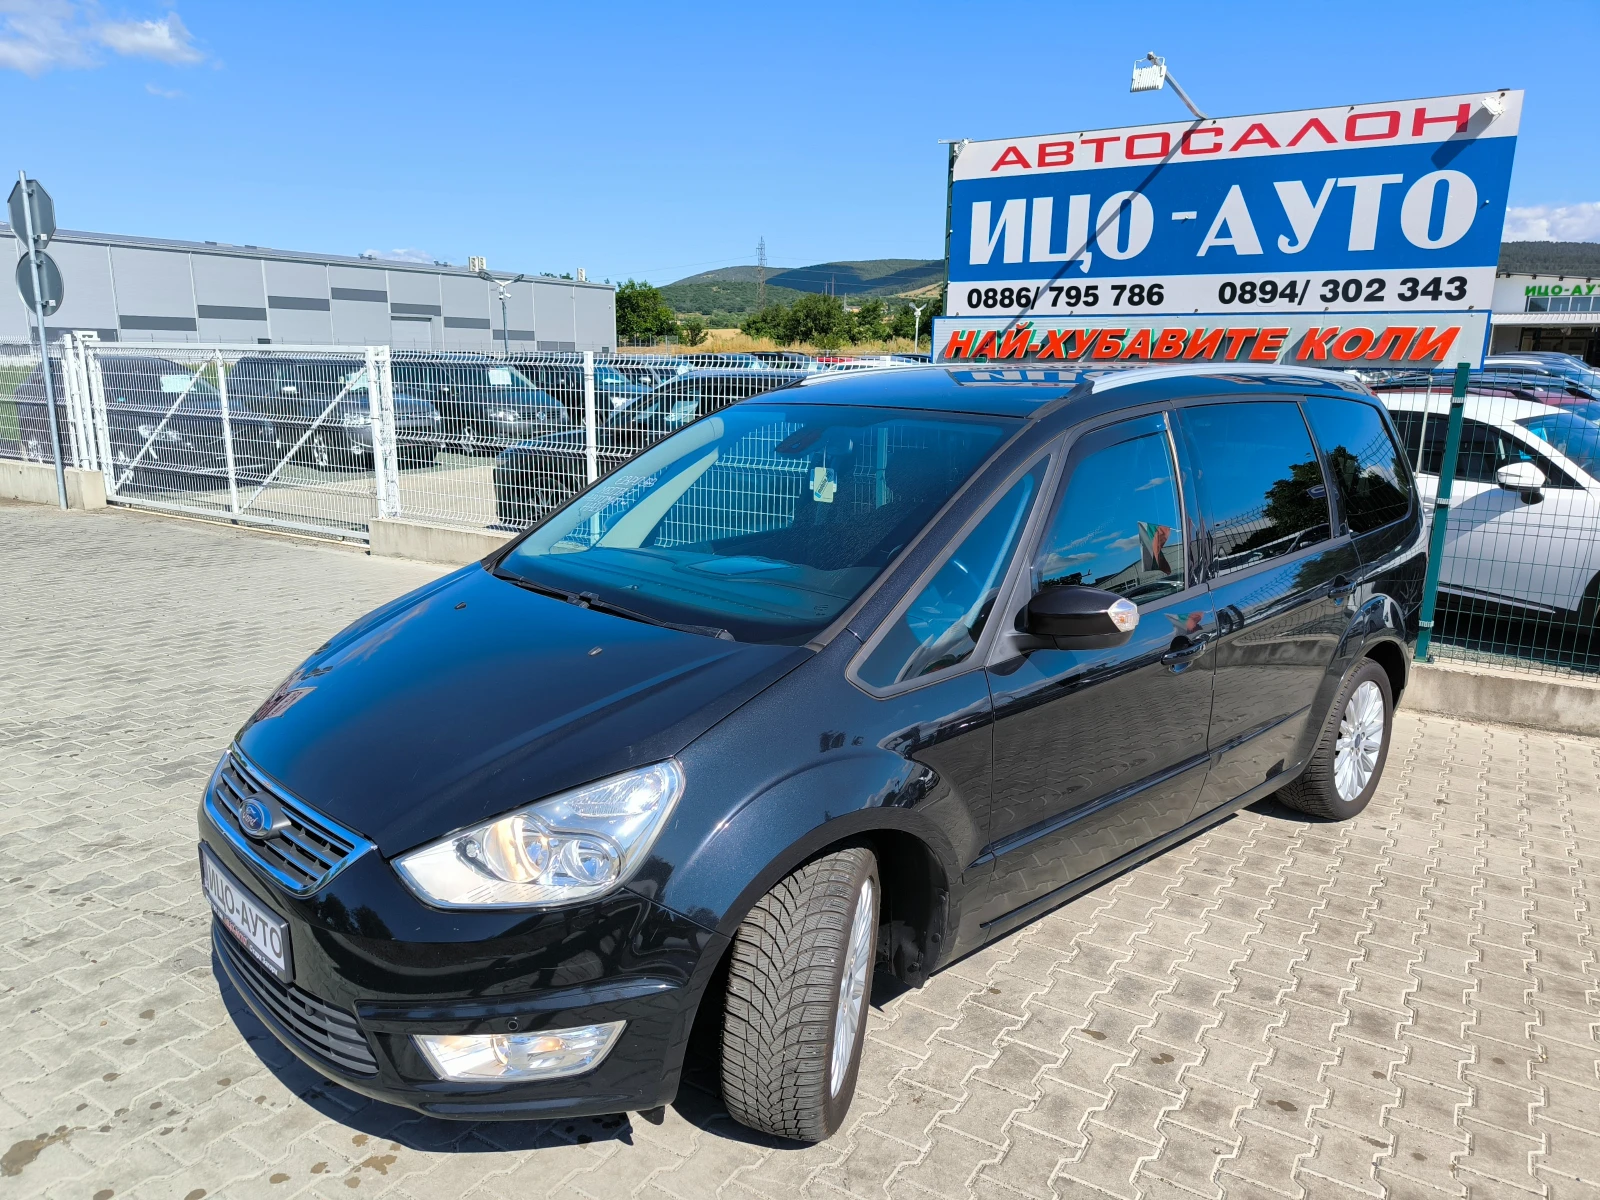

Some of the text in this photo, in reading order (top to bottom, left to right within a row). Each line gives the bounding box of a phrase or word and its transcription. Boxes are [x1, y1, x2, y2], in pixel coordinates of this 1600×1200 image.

[990, 103, 1471, 171] АВТОСАЛОН
[967, 276, 1467, 310] 0886/ 795 786 0894/ 302 343
[1525, 284, 1600, 297] ИЦО-АУ
[944, 321, 1463, 361] НАЙ-ХУБАВИТЕ КОЛИ
[242, 811, 259, 827] Ford
[207, 863, 283, 959] ИЦО-АУТО
